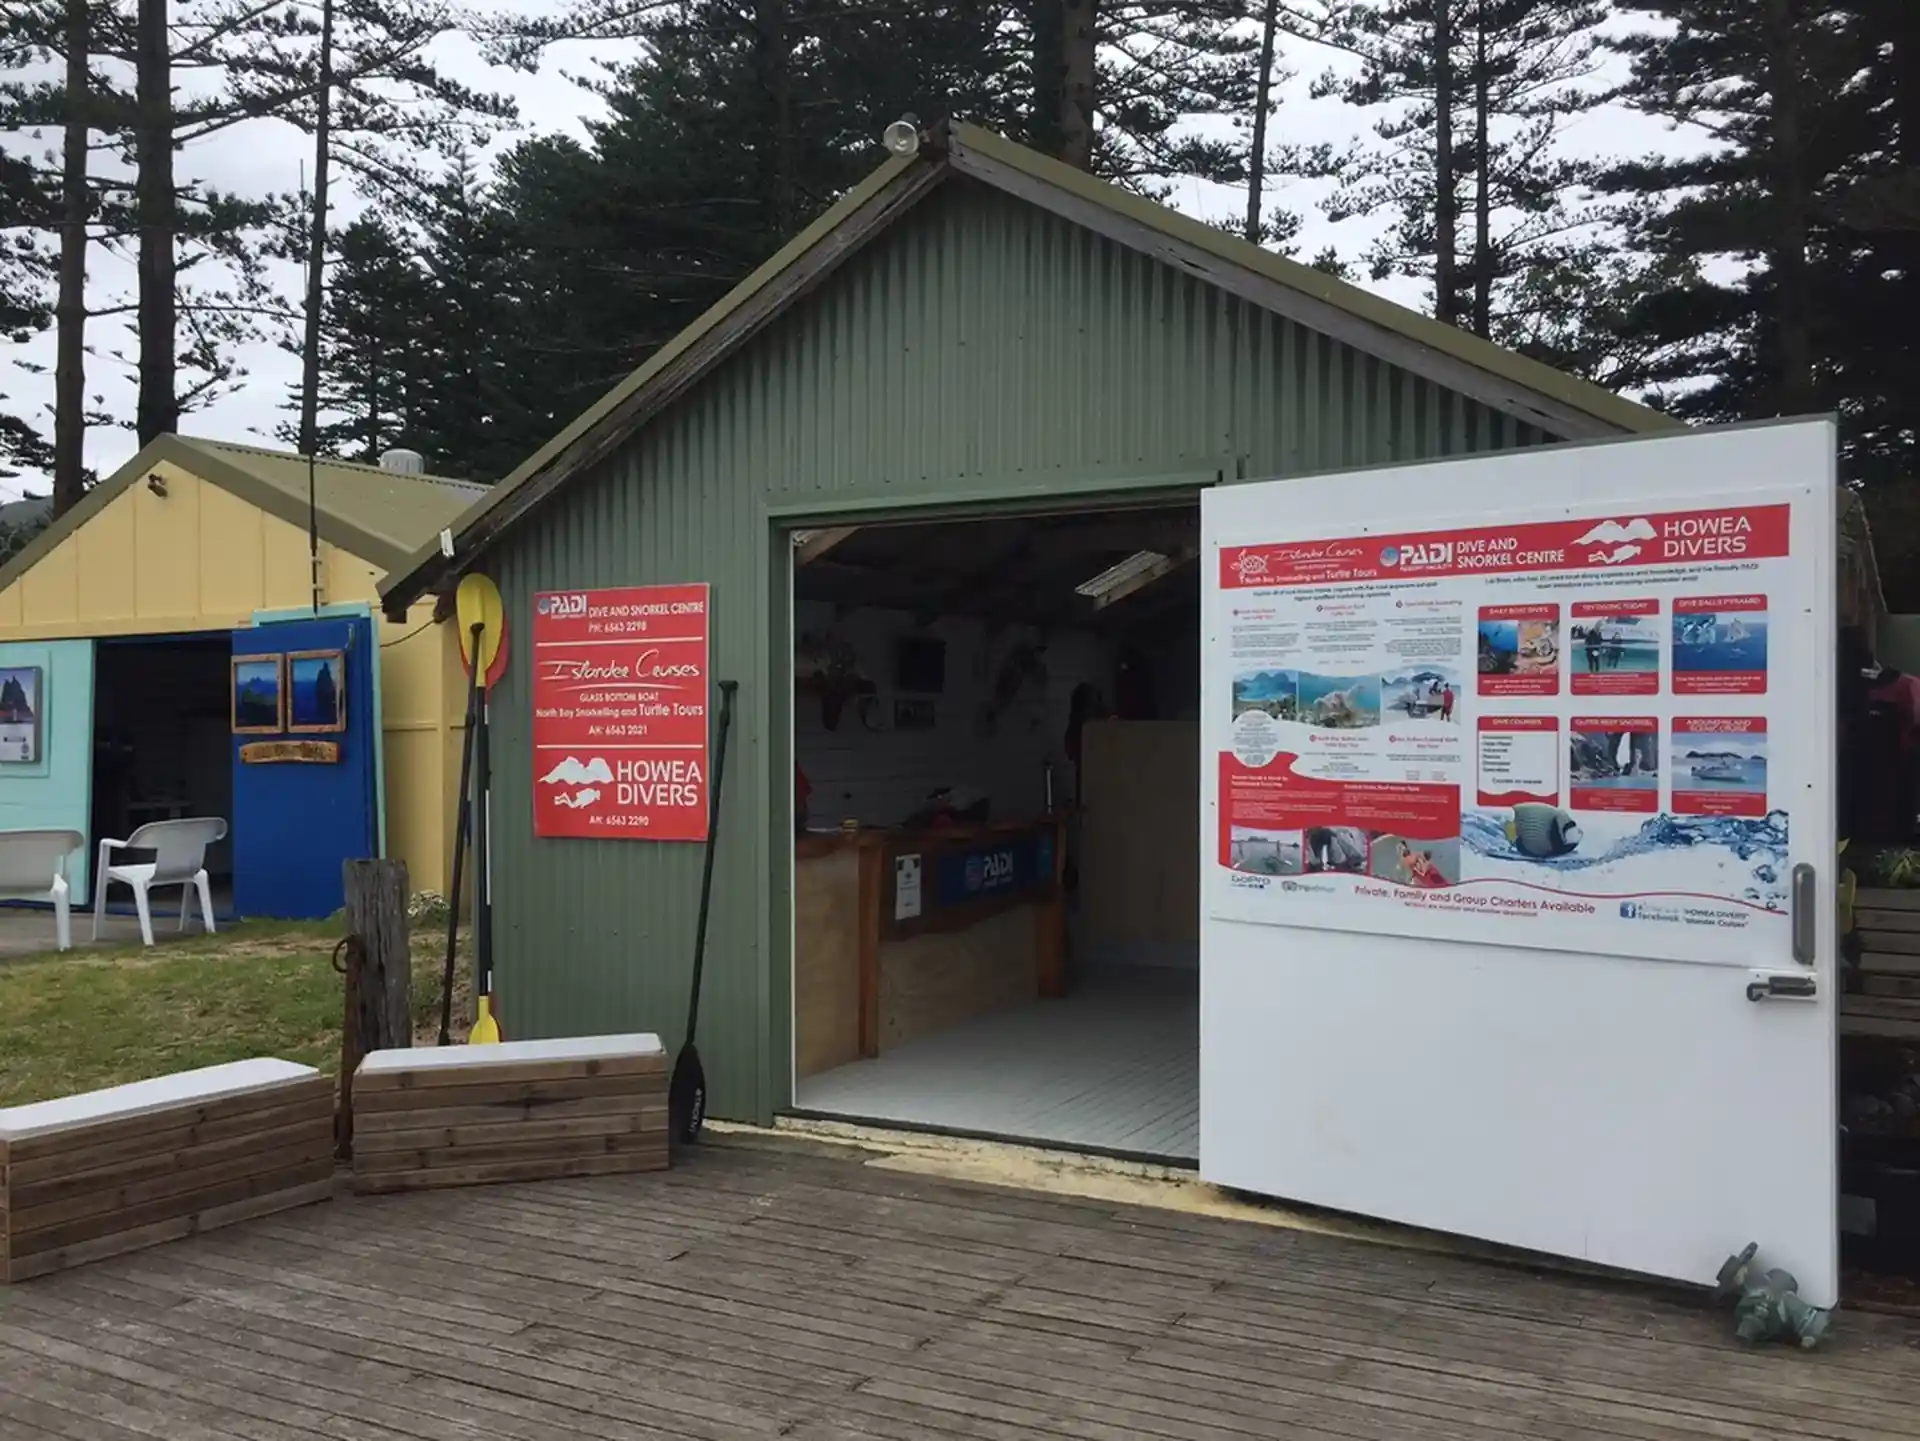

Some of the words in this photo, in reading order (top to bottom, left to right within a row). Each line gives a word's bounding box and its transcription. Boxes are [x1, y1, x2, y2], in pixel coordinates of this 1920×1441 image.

[1663, 516, 1752, 537] HOWEA
[1400, 542, 1453, 565] PADI
[1457, 541, 1485, 554] DIVE
[1488, 538, 1518, 551] AND
[1663, 536, 1747, 557] DIVERS
[1457, 553, 1512, 568] SNORKEL
[1515, 549, 1565, 564] CENTRE
[550, 595, 587, 614] PADI
[589, 606, 608, 618] DIVE
[609, 605, 629, 617] AND
[630, 602, 670, 616] SNORKEL
[670, 601, 704, 614] CENTRE
[604, 621, 625, 633] 6563
[579, 692, 603, 702] GLASS
[605, 692, 636, 702] BOTTOM
[638, 692, 659, 701] BOAT
[559, 708, 574, 719] Bay
[621, 707, 637, 717] and
[639, 703, 670, 716] Turtle
[672, 702, 704, 716] Tours
[605, 724, 626, 736] 6563
[617, 760, 703, 783] HOWEA
[617, 784, 698, 806] DIVERS
[606, 815, 626, 826] 6563
[984, 850, 1013, 878] PADI
[1354, 885, 1390, 898] Private,
[1394, 888, 1428, 901] Family
[1429, 891, 1450, 902] and
[1452, 893, 1487, 906] Group
[1490, 896, 1538, 909] Charters
[1540, 899, 1596, 914] Available
